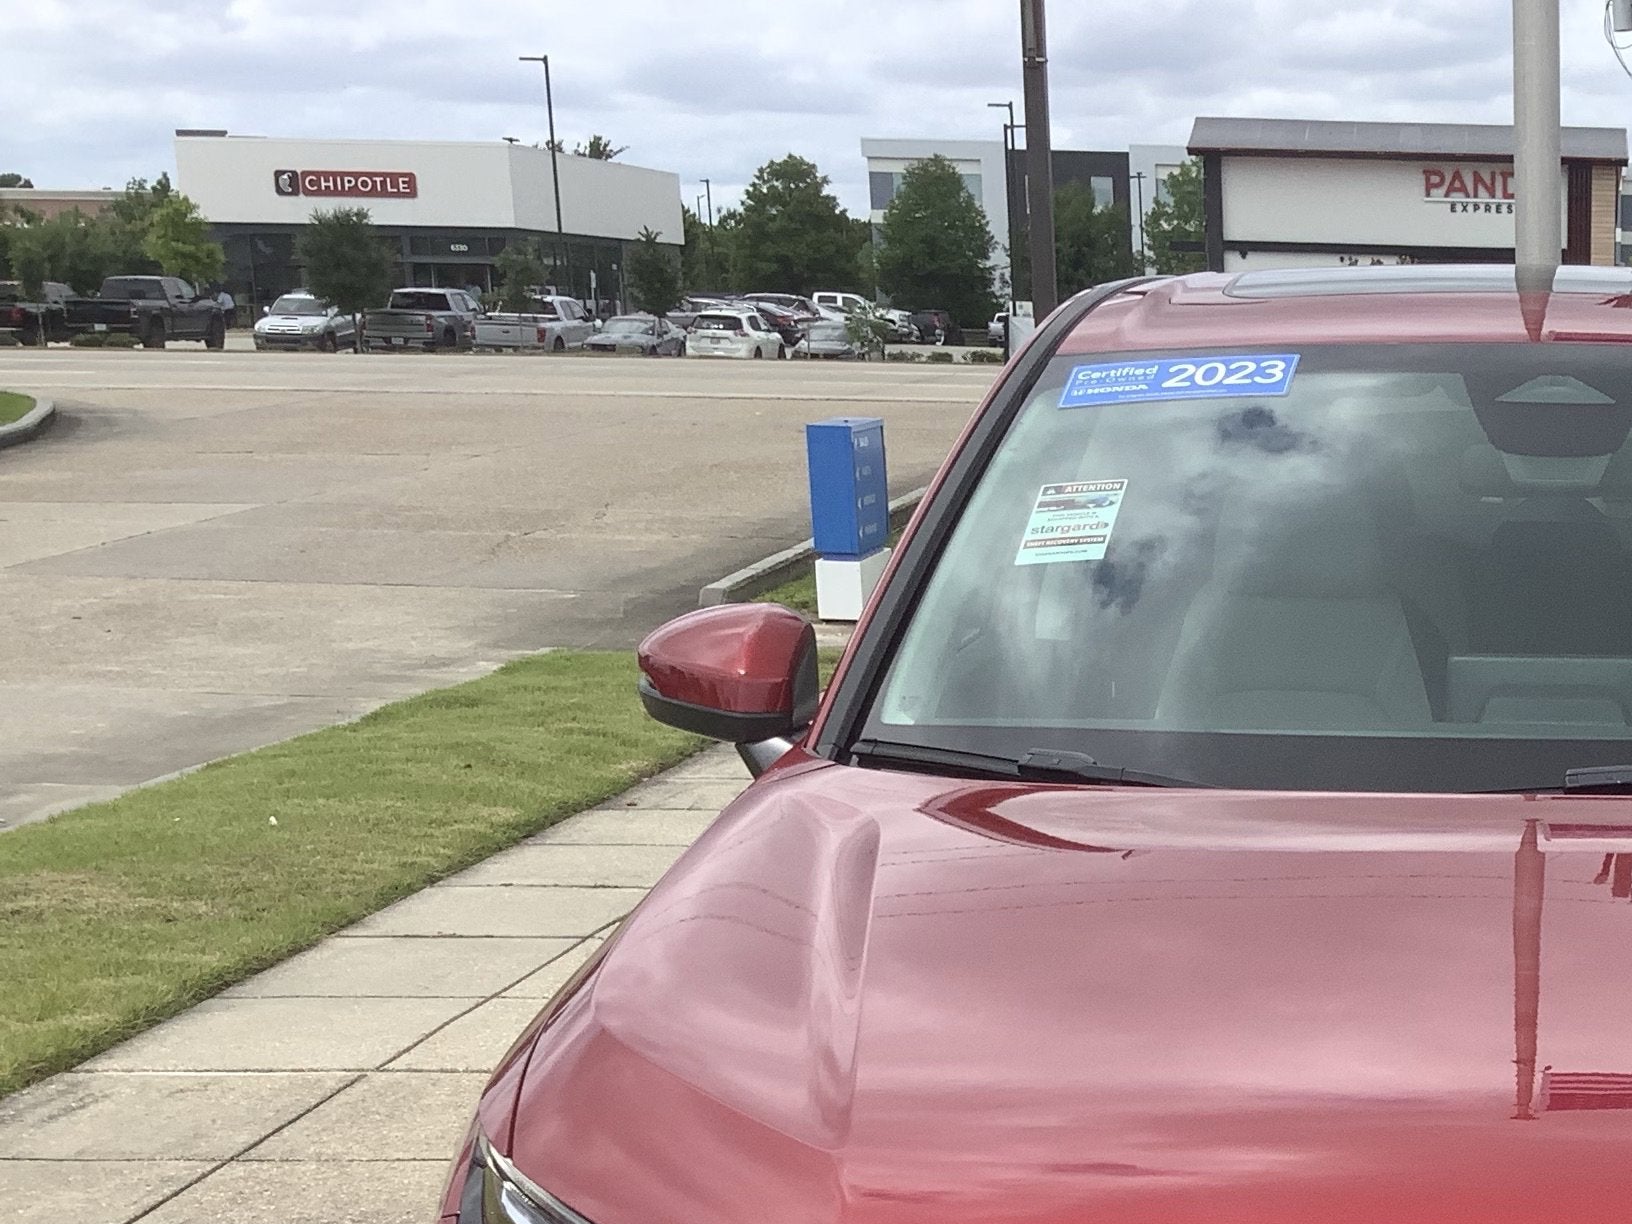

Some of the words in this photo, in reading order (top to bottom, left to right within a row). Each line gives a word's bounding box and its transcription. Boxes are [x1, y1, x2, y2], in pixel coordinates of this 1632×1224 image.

[304, 175, 411, 193] CHIPOTLE
[1422, 169, 1515, 199] PAND
[1450, 202, 1514, 214] EXPRES
[1077, 364, 1159, 381] Certified
[1161, 359, 1287, 388] 2023
[1086, 383, 1149, 395] HONDA
[1064, 482, 1121, 494] ATTENTION
